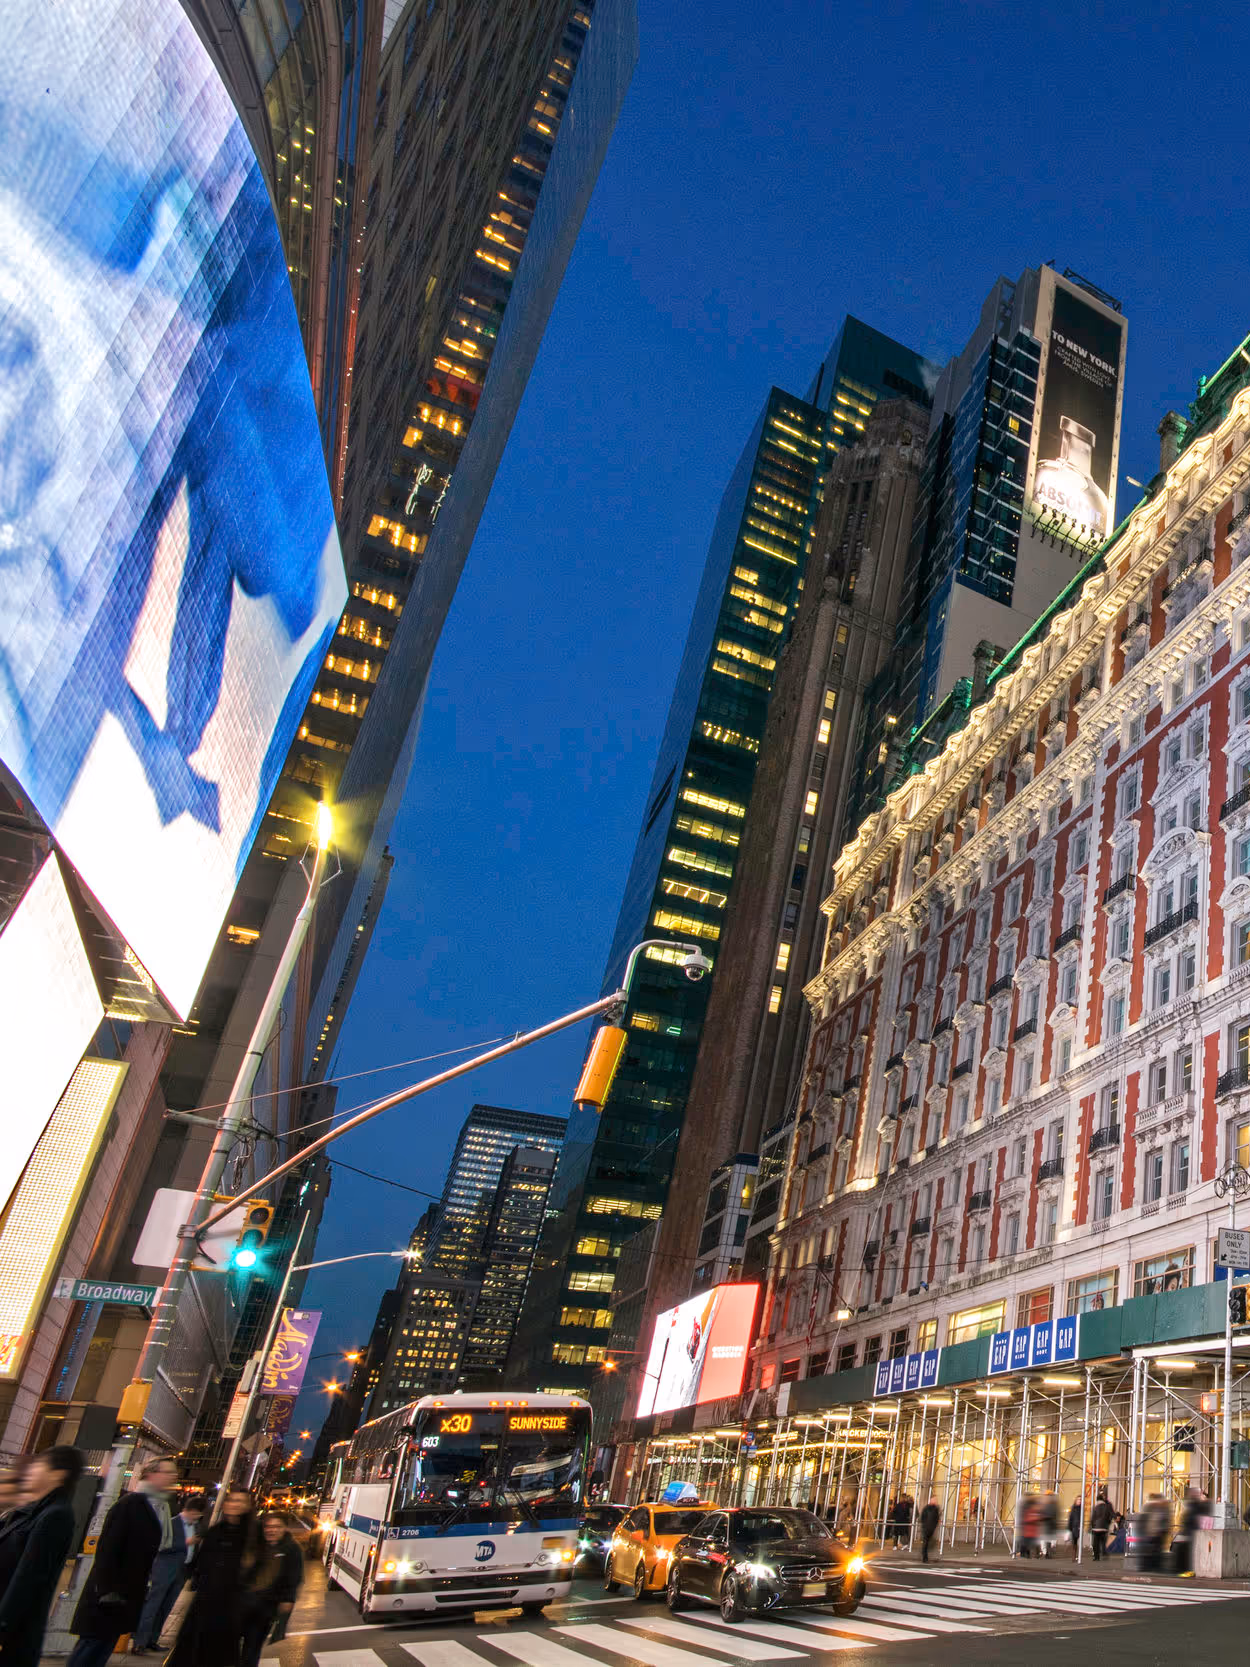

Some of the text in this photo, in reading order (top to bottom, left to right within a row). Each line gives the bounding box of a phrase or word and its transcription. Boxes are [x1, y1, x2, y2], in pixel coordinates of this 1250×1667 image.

[1052, 330, 1117, 378] TO NEW YORK.
[1225, 1232, 1244, 1240] BUSES
[78, 1283, 153, 1306] Broadway
[1016, 1335, 1027, 1353] GAP
[1037, 1330, 1048, 1348] GAP
[1059, 1328, 1073, 1349] GAP
[994, 1345, 1007, 1365] GAP
[895, 1363, 904, 1379] GAP
[909, 1360, 919, 1376] GAP
[924, 1359, 936, 1376] GAP
[879, 1371, 889, 1388] GAP
[509, 1416, 567, 1431] SUNNYSIDE
[422, 1436, 439, 1447] 603
[474, 1543, 495, 1561] MTA
